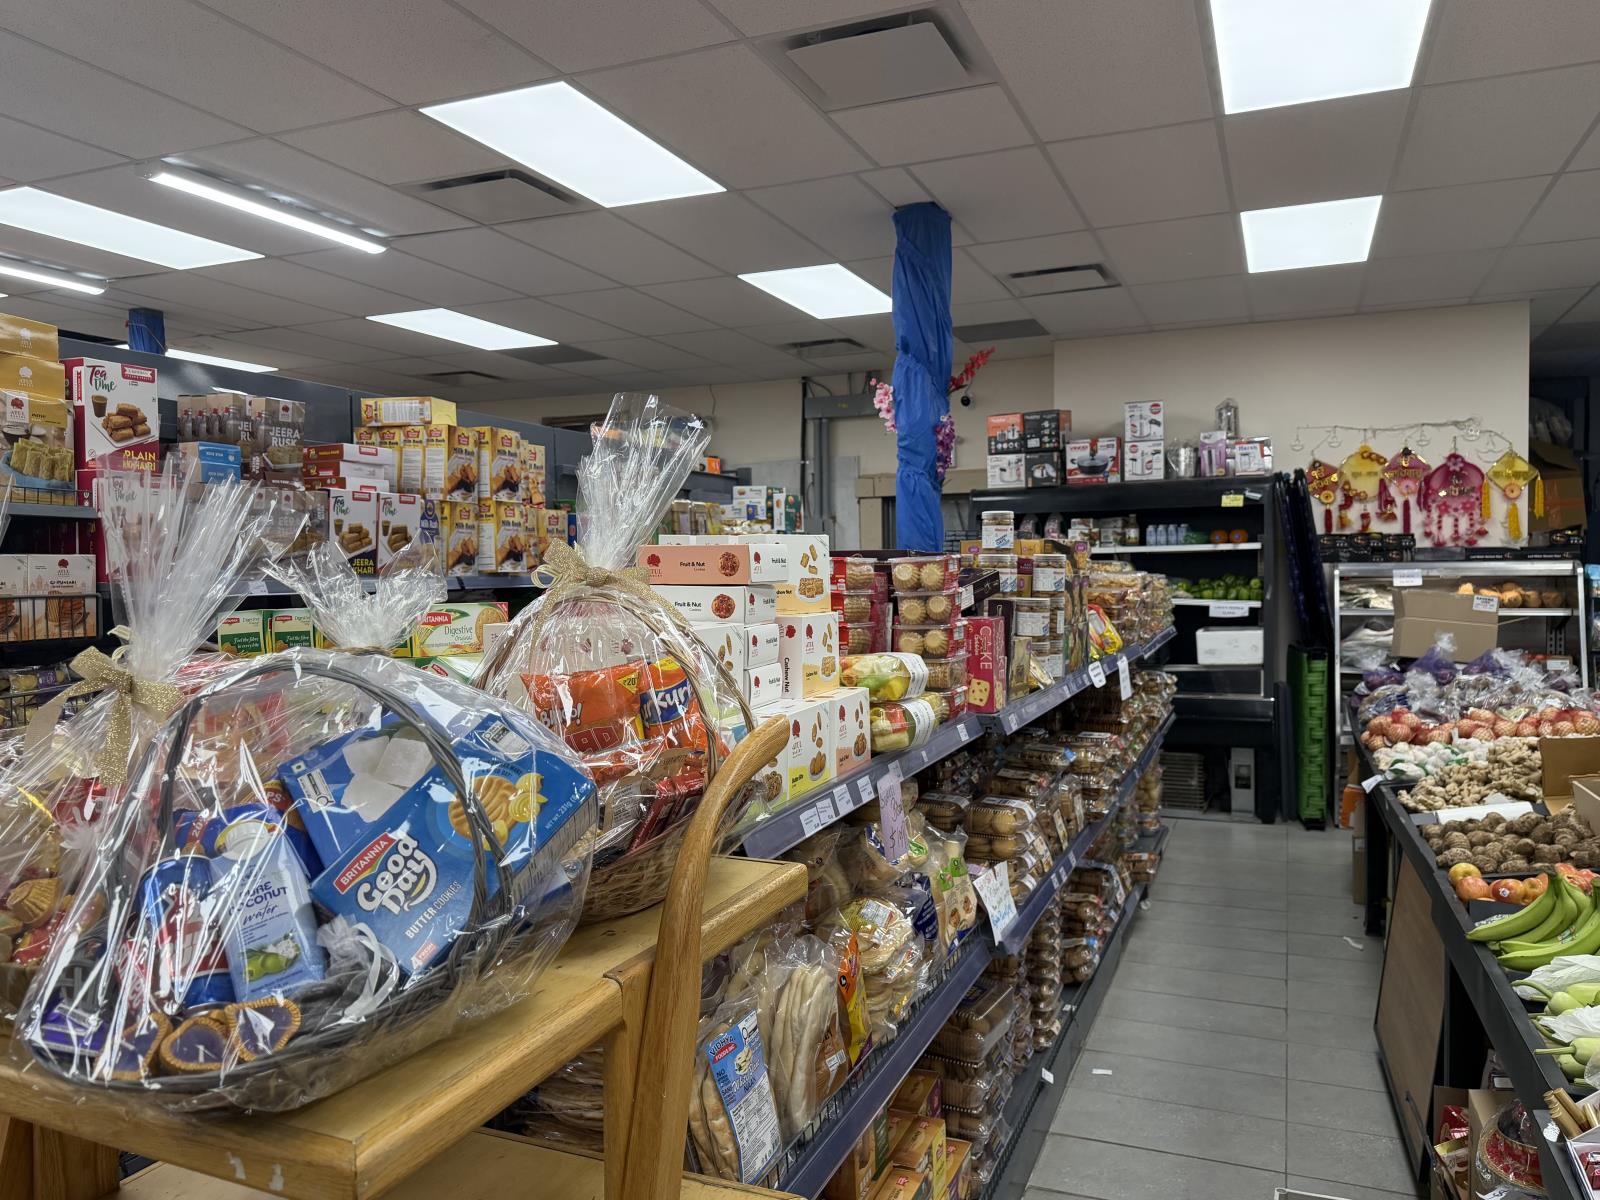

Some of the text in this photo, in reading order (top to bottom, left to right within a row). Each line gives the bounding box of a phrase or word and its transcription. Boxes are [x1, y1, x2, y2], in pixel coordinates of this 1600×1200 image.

[86, 365, 107, 386] Tea
[269, 426, 301, 440] JEERA
[271, 436, 297, 448] RUSK
[123, 450, 156, 461] PLAIN
[352, 558, 375, 566] JEERA
[444, 624, 473, 637] Digestive
[340, 839, 389, 886] BRITANNIA
[356, 833, 418, 912] Good
[380, 849, 437, 915] Day
[242, 901, 278, 926] water
[404, 881, 462, 939] BUTTER COOKIES
[709, 1035, 734, 1057] VIDHYA
[716, 1068, 726, 1078] NO
